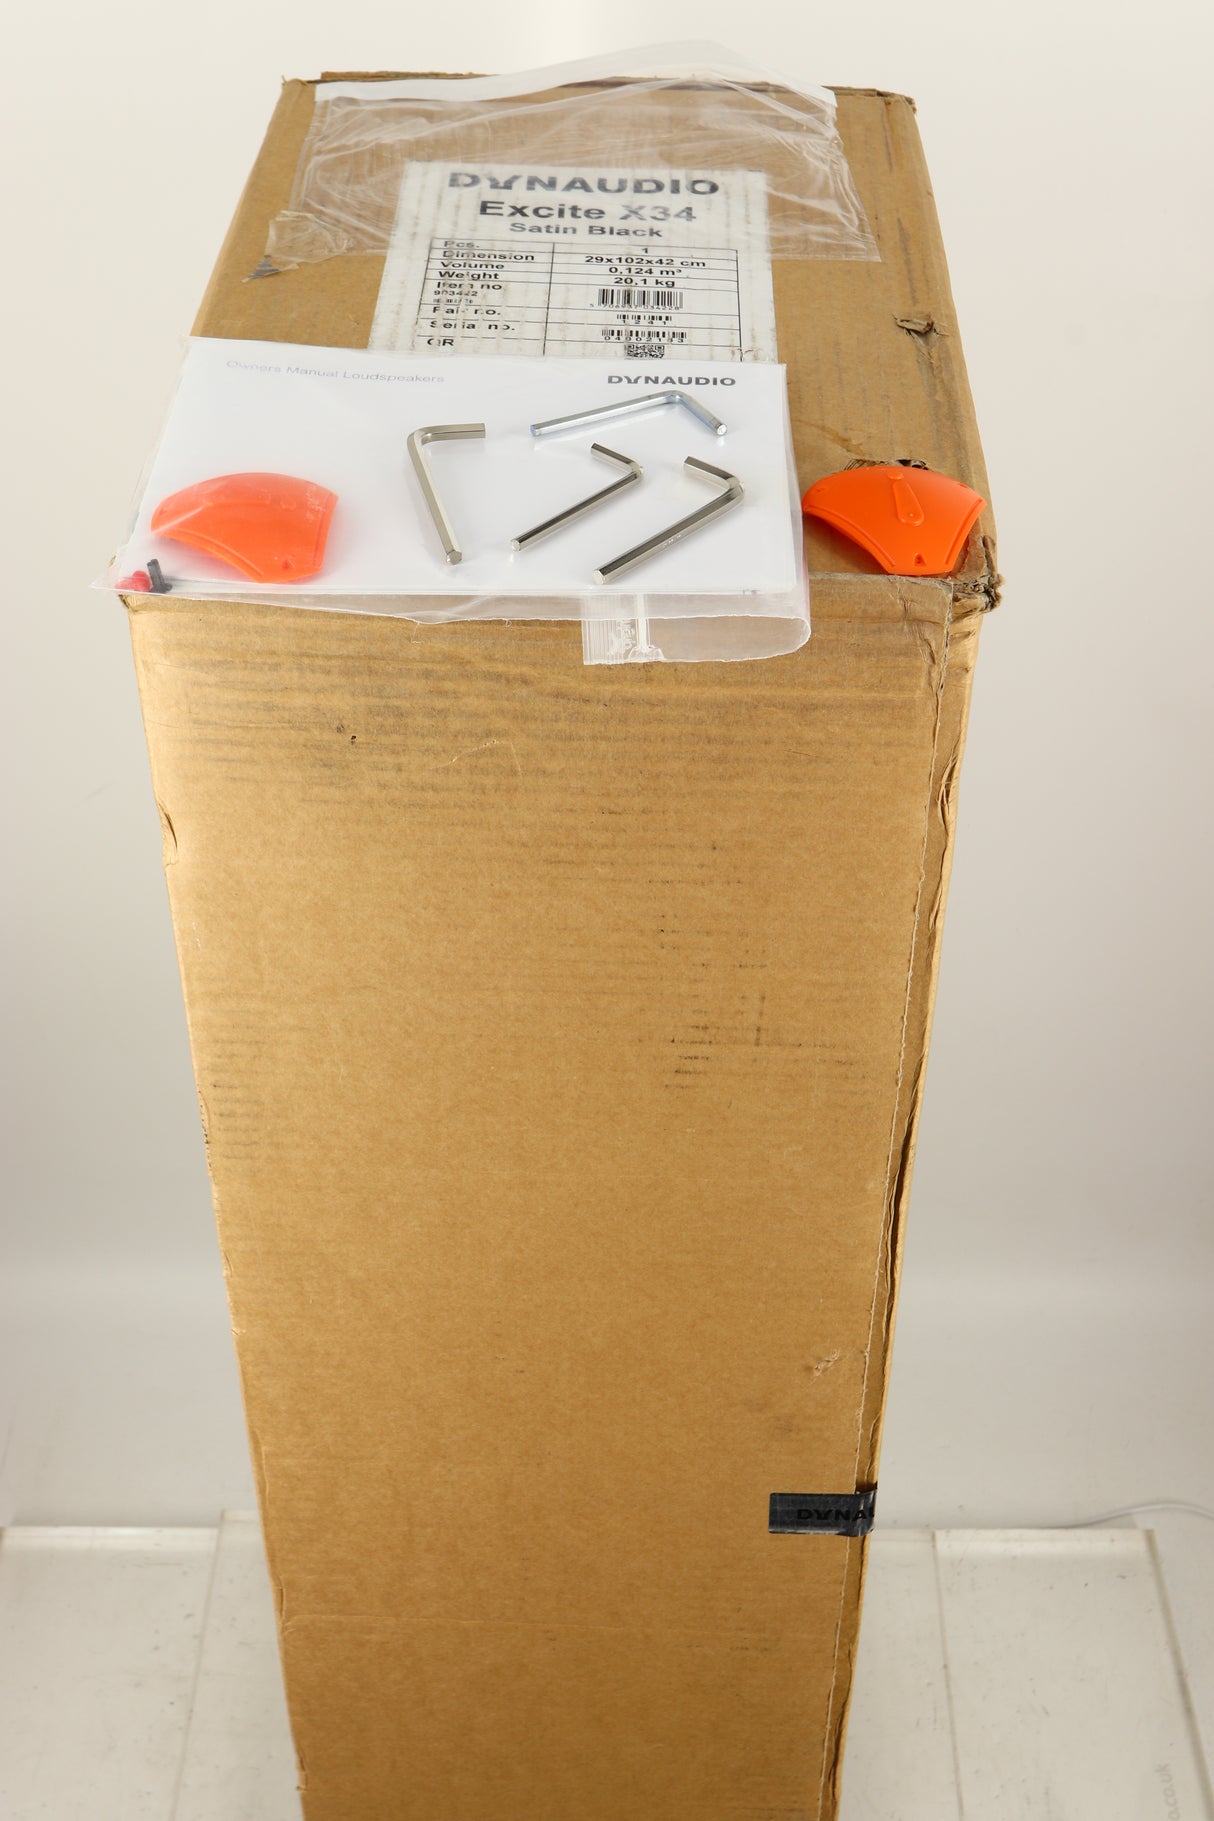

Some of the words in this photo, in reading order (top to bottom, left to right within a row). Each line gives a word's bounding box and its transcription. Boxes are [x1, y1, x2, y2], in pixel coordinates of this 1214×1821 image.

[448, 172, 720, 195] DYNAUDIO
[479, 200, 606, 220] Excite
[618, 204, 697, 222] X34
[509, 222, 577, 235] Satin
[588, 225, 664, 238] Black
[444, 240, 480, 248] Pcs.
[442, 250, 535, 261] Dimension
[584, 255, 675, 266] 29x102x42
[441, 261, 505, 270] Volume
[438, 270, 500, 281] Weight
[480, 283, 503, 291] no
[655, 279, 676, 288] kg
[226, 360, 282, 374] Owners
[285, 366, 339, 379] Manual
[342, 371, 446, 384] Loudspeakers
[607, 375, 737, 387] DYNAUDIO
